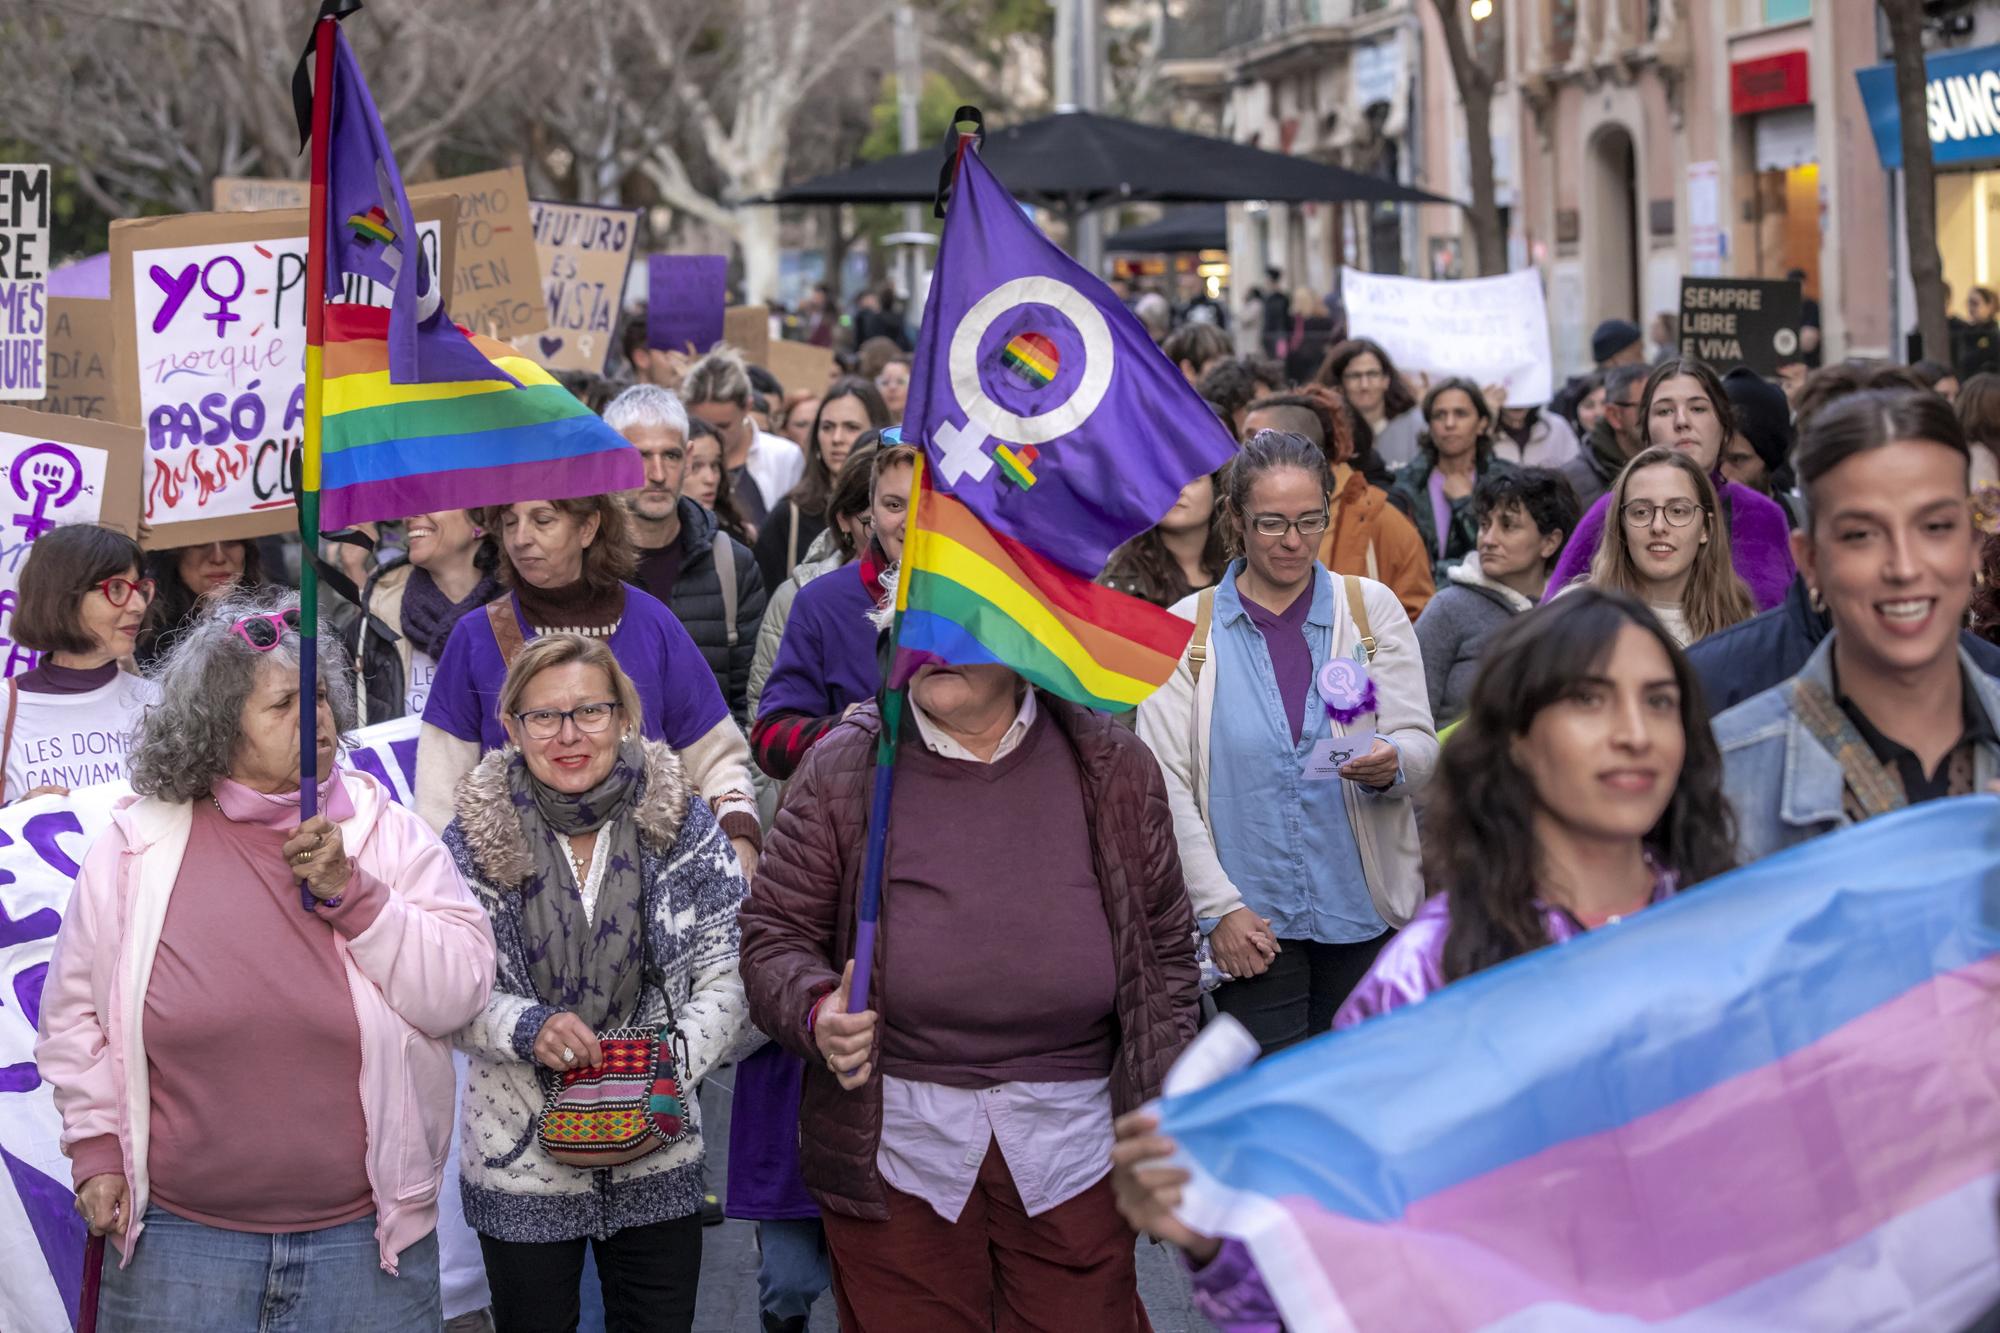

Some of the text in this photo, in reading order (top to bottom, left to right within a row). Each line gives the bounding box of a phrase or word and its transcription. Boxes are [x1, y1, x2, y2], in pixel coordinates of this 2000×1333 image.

[551, 254, 577, 279] ES
[1684, 287, 1762, 311] SEMPRE
[1682, 313, 1737, 335] LIBRE
[1699, 339, 1744, 360] VIVA
[149, 378, 266, 451] PASÓ
[25, 737, 63, 765] LES
[26, 762, 120, 791] CANVIAM
